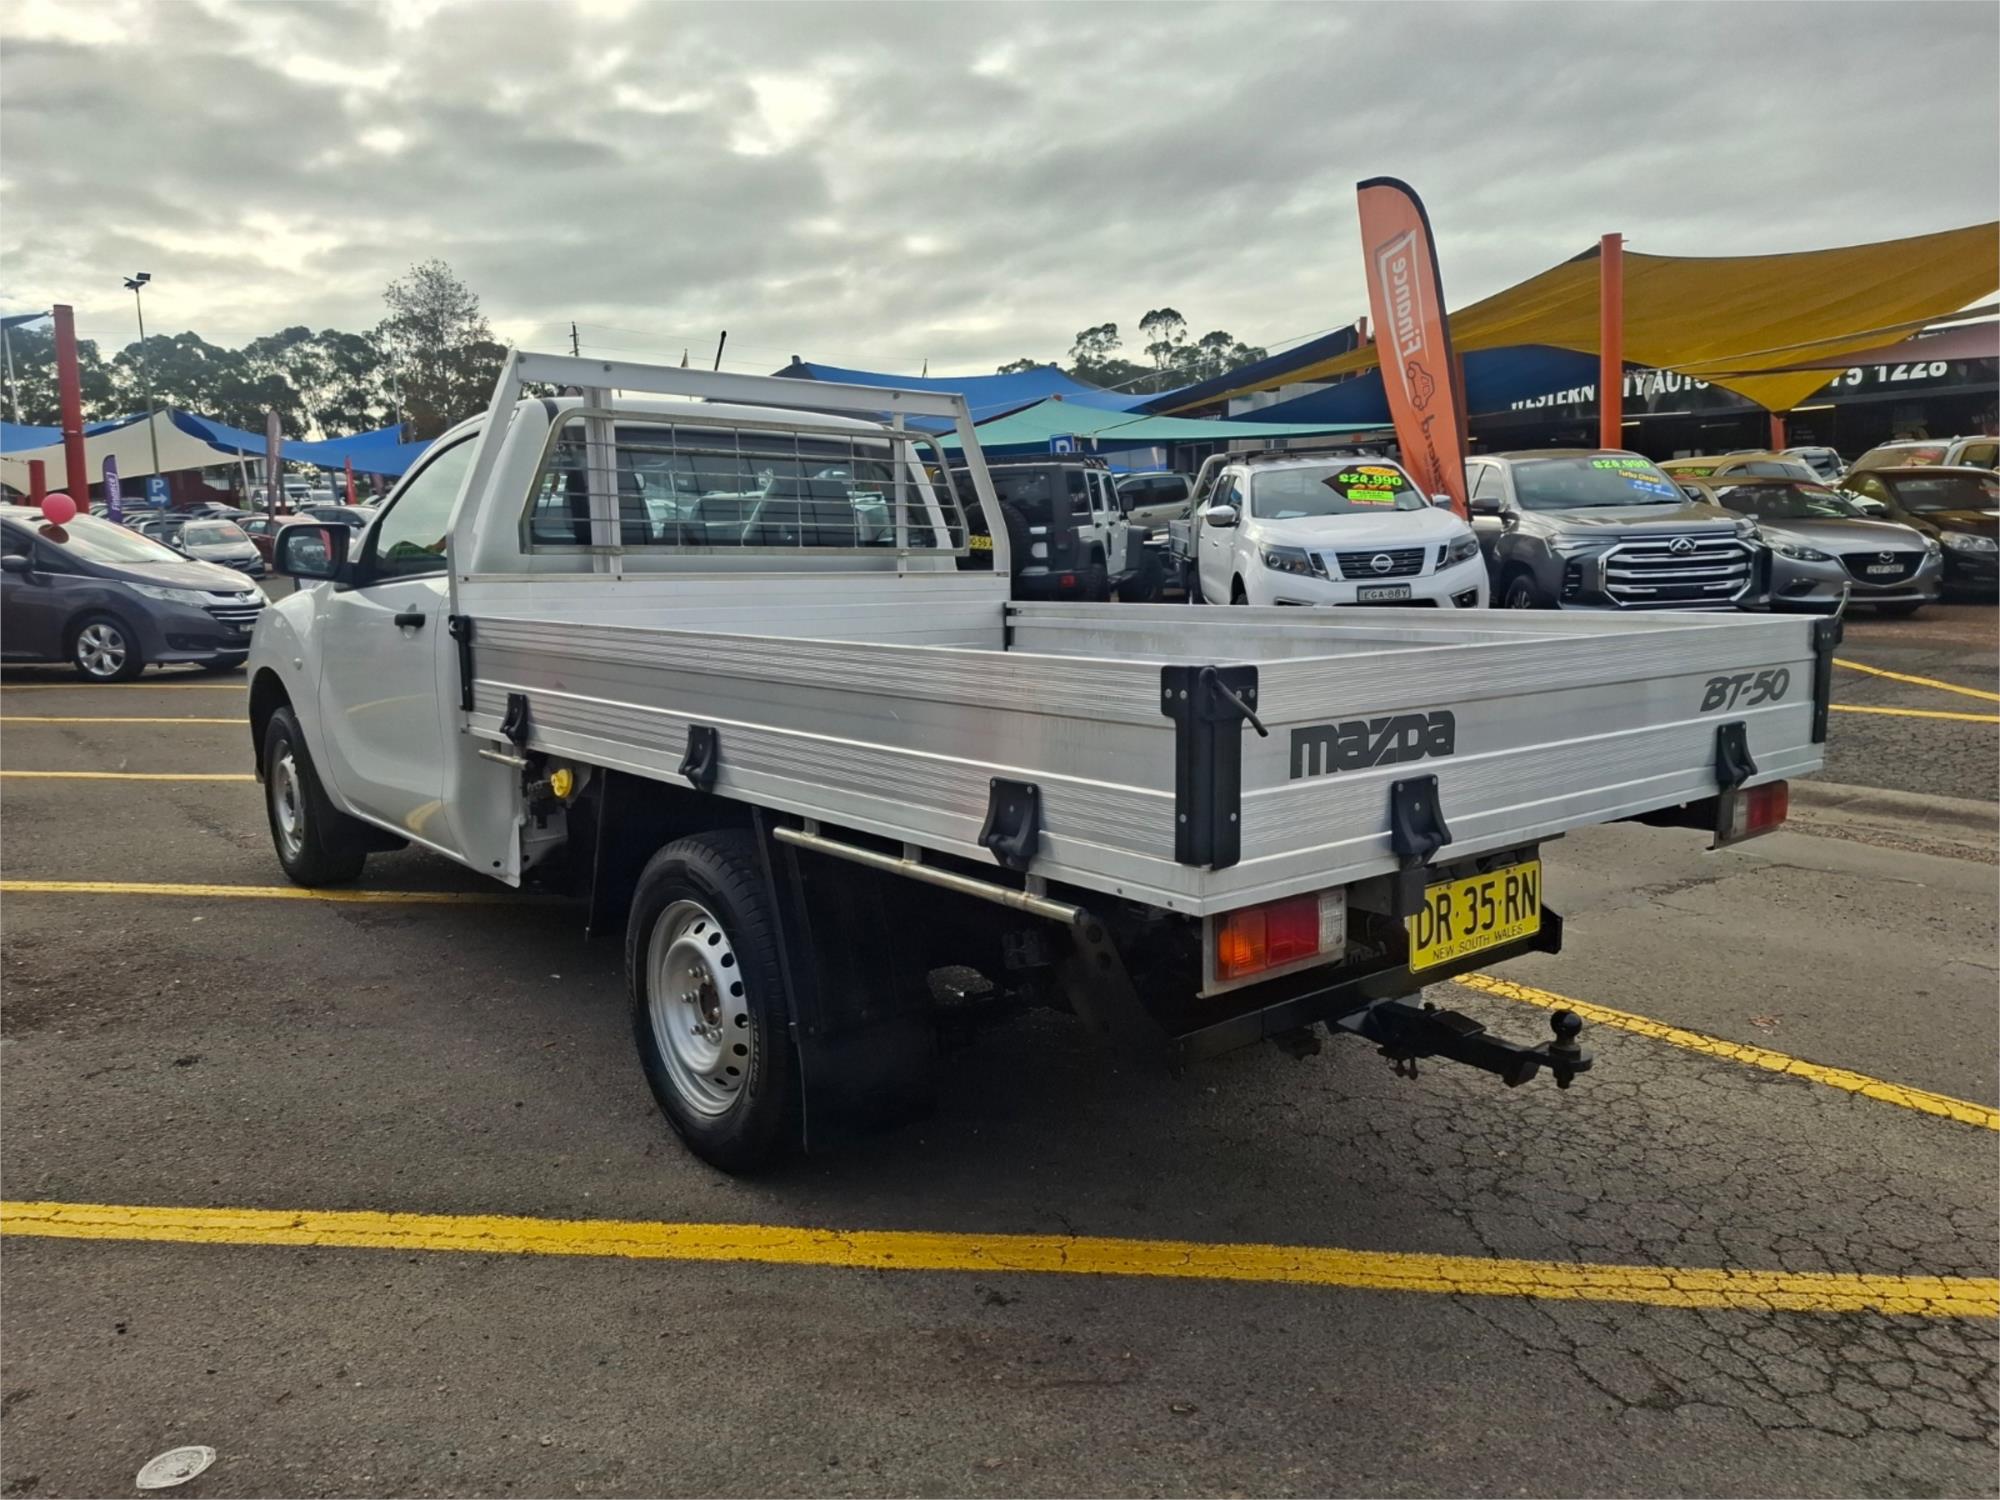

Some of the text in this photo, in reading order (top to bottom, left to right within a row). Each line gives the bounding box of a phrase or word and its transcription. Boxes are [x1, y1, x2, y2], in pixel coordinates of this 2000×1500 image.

[1874, 361, 1948, 382] 1228
[151, 479, 164, 493] P
[1701, 668, 1790, 711] BT-50
[1433, 923, 1523, 960] NEW SOUTH WALES
